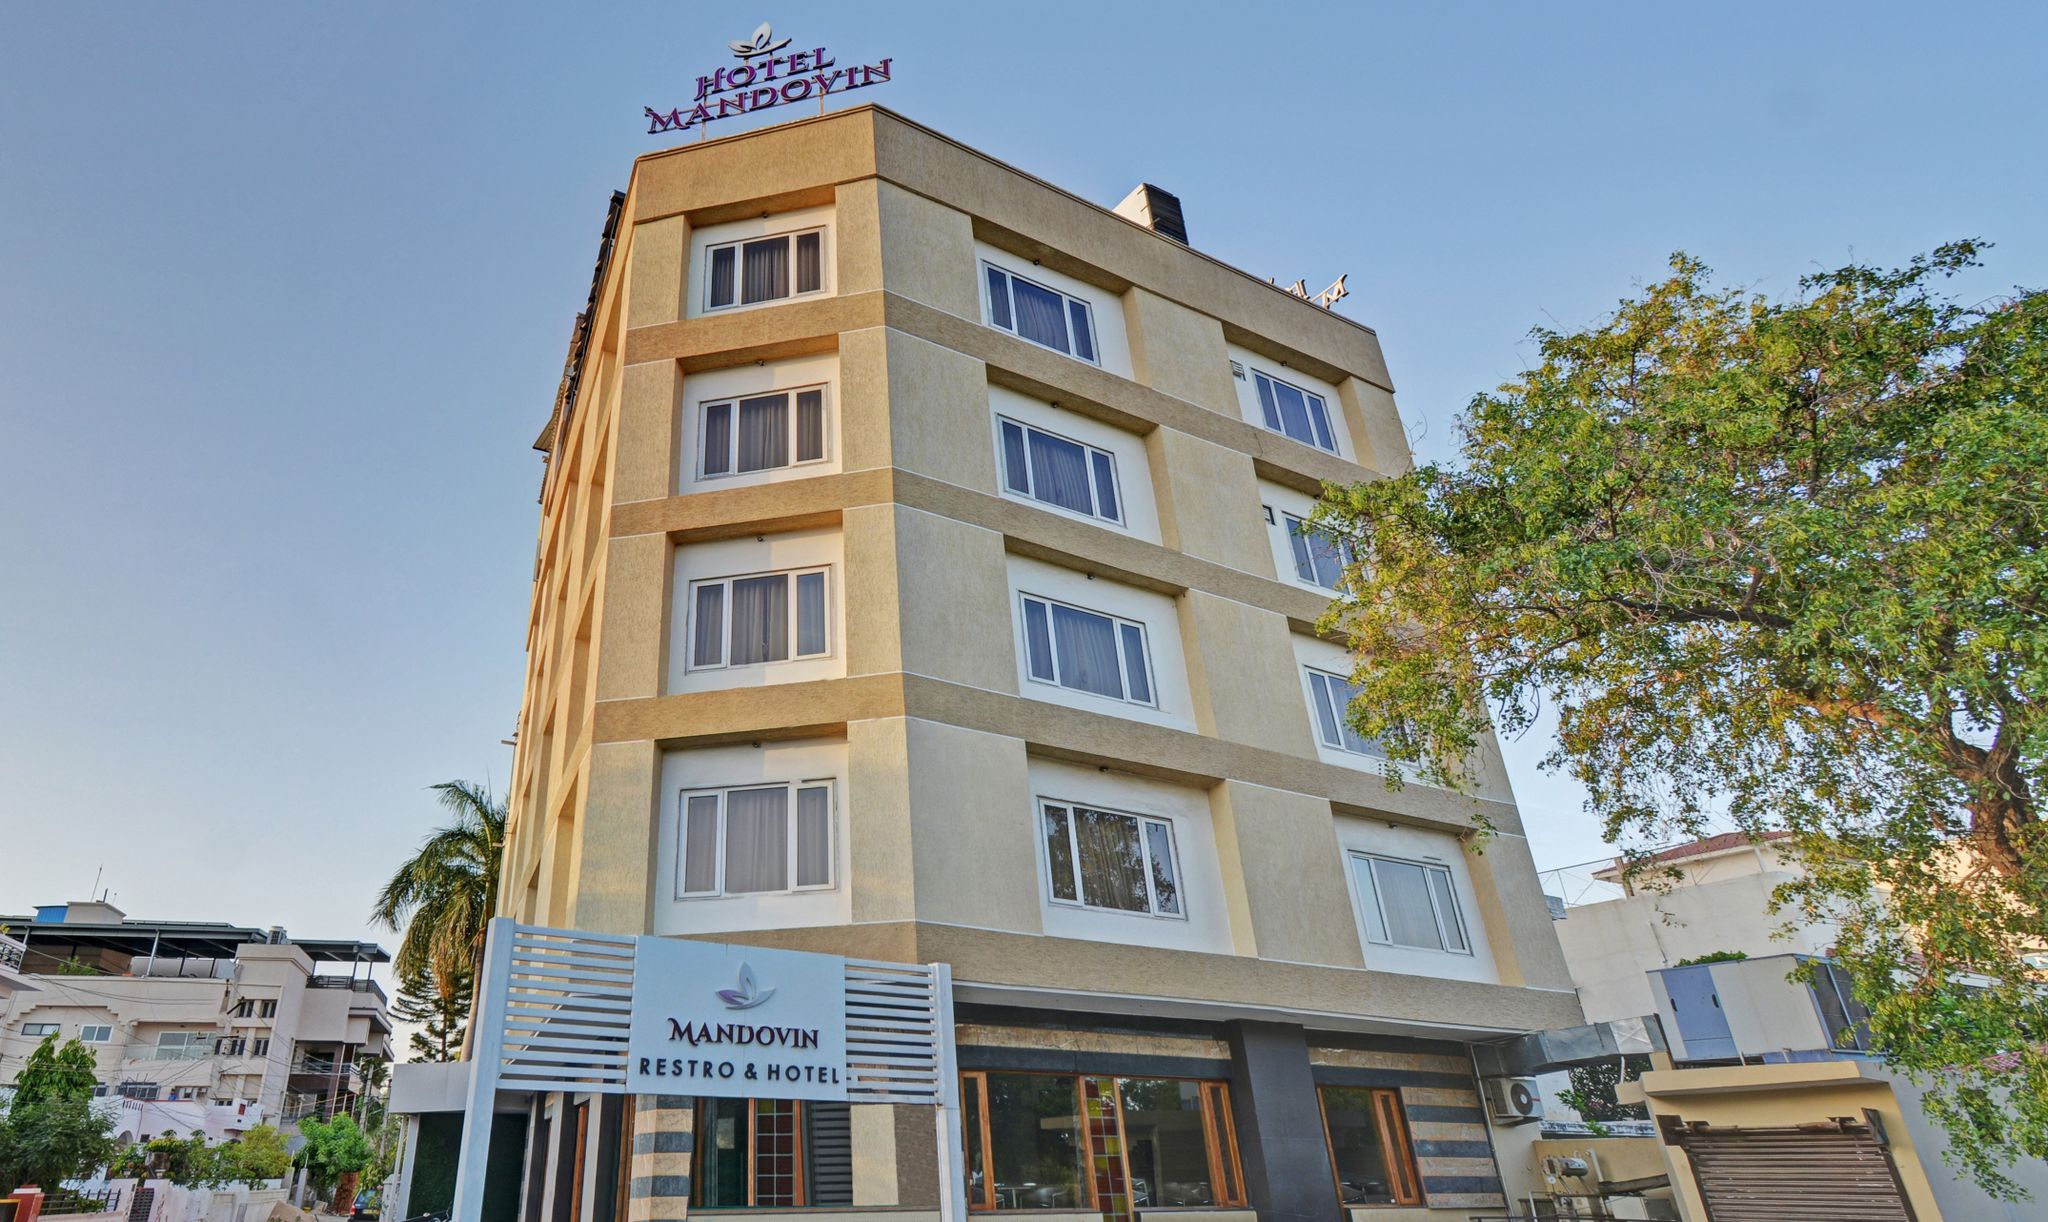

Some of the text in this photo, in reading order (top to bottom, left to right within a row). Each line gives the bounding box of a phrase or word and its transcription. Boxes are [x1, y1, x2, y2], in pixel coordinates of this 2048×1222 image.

[694, 47, 835, 101] HOTEL
[644, 58, 892, 134] MANDOVIN
[667, 1018, 819, 1049] MANDOVIN
[639, 1057, 840, 1084] RESTRO & HOTEL
